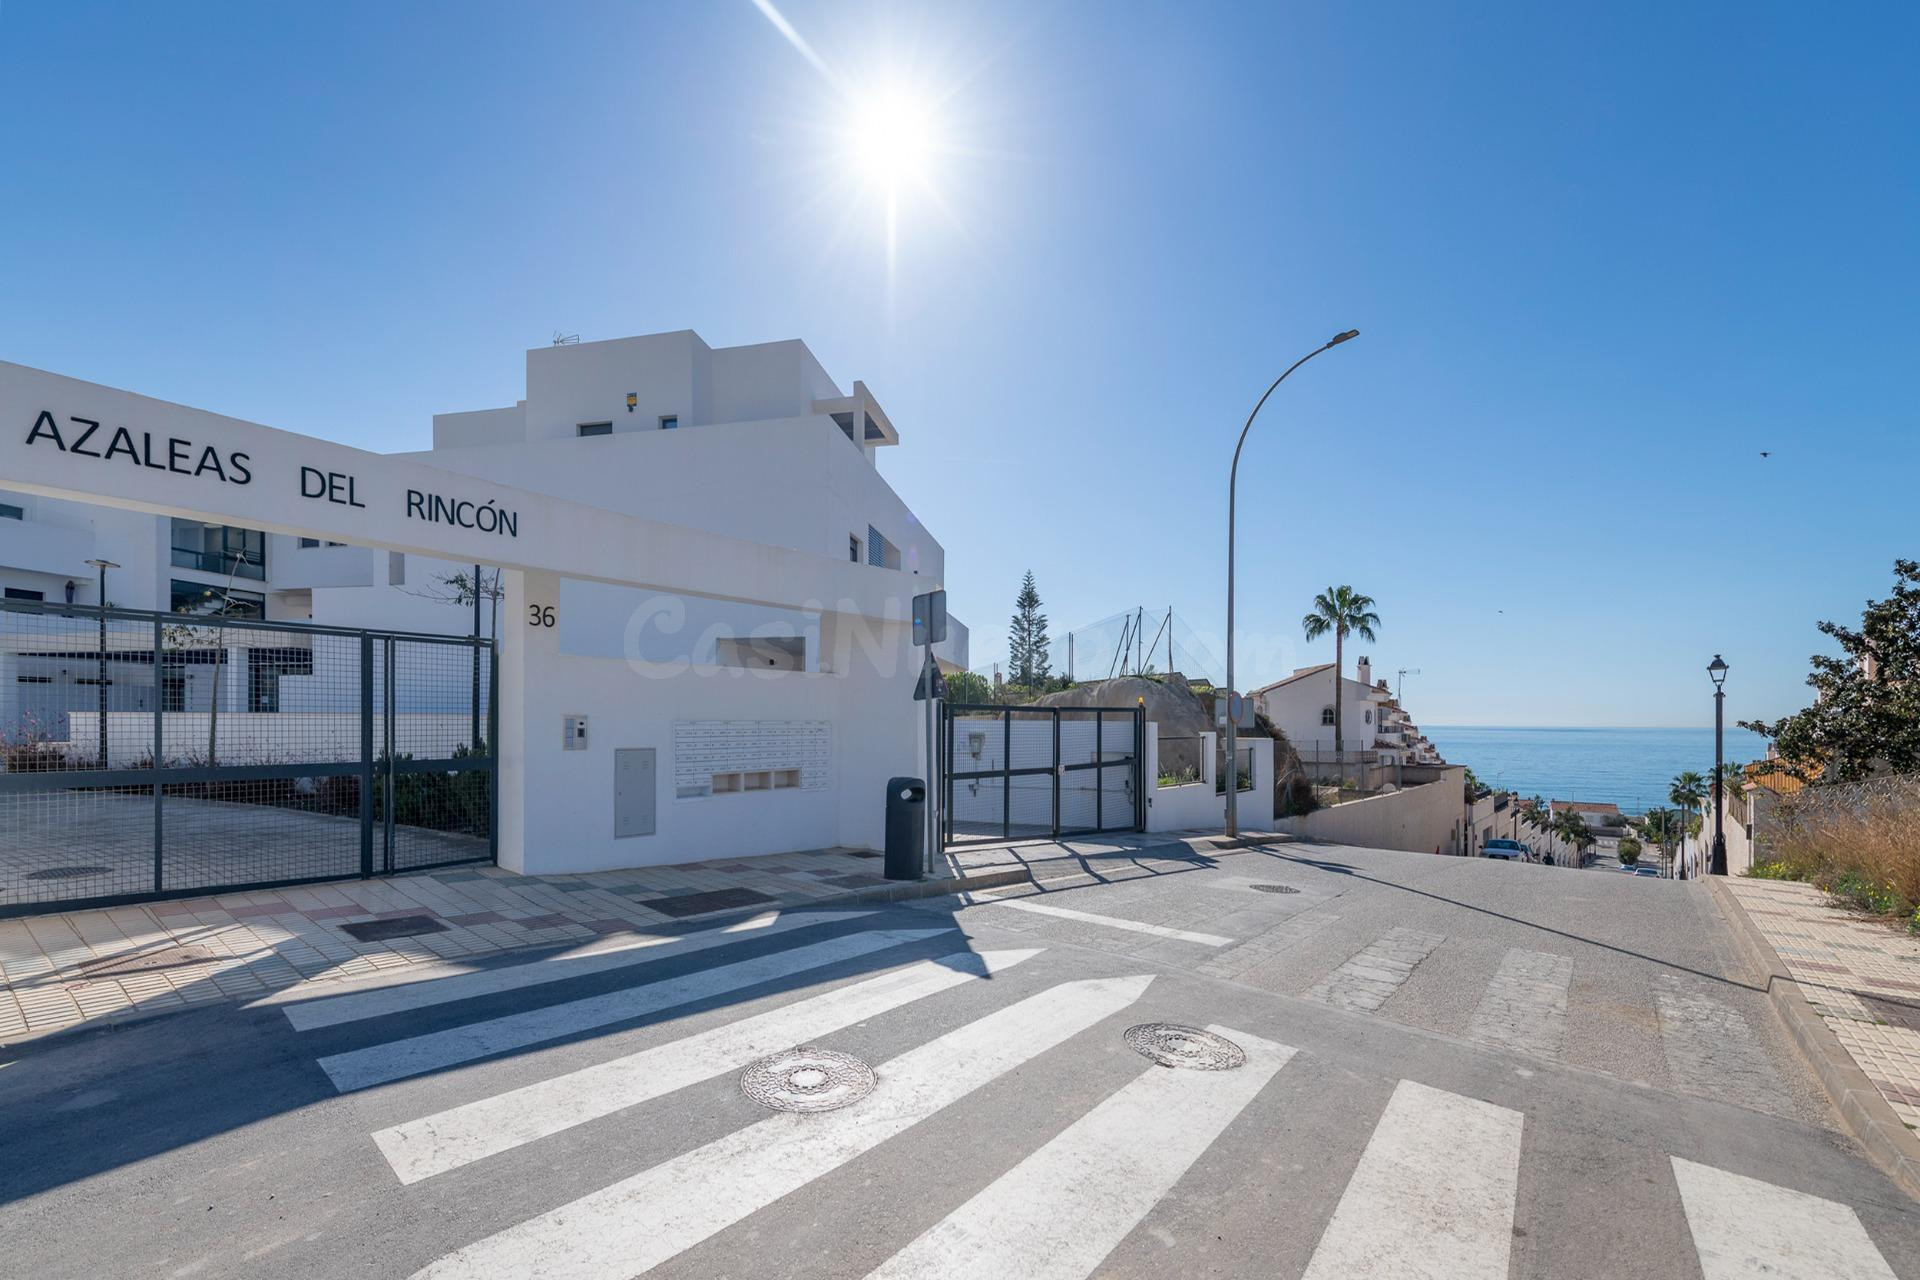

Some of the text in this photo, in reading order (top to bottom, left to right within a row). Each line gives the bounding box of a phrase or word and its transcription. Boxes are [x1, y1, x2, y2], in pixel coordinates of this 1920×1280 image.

[25, 410, 518, 538] AZALEAS DEL RINCÓN
[528, 604, 556, 628] 36
